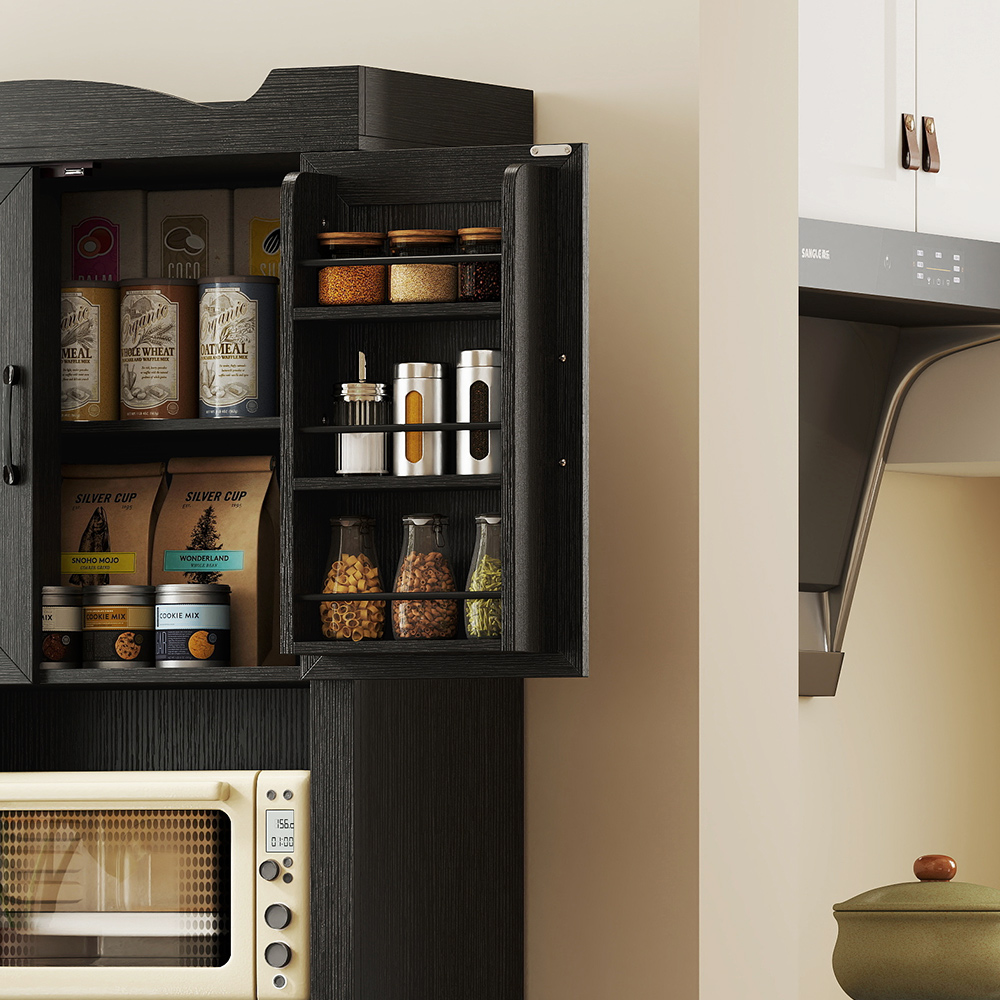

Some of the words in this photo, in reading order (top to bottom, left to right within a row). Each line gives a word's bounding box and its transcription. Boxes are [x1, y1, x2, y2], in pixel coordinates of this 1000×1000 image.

[168, 262, 200, 279] COCO
[142, 347, 175, 357] WHEAT
[200, 343, 249, 355] OATMEAL
[75, 493, 112, 504] SILVER
[114, 492, 138, 503] CUP
[185, 491, 222, 502] SILVER
[224, 491, 248, 502] CUP
[271, 836, 294, 847] 01:00
